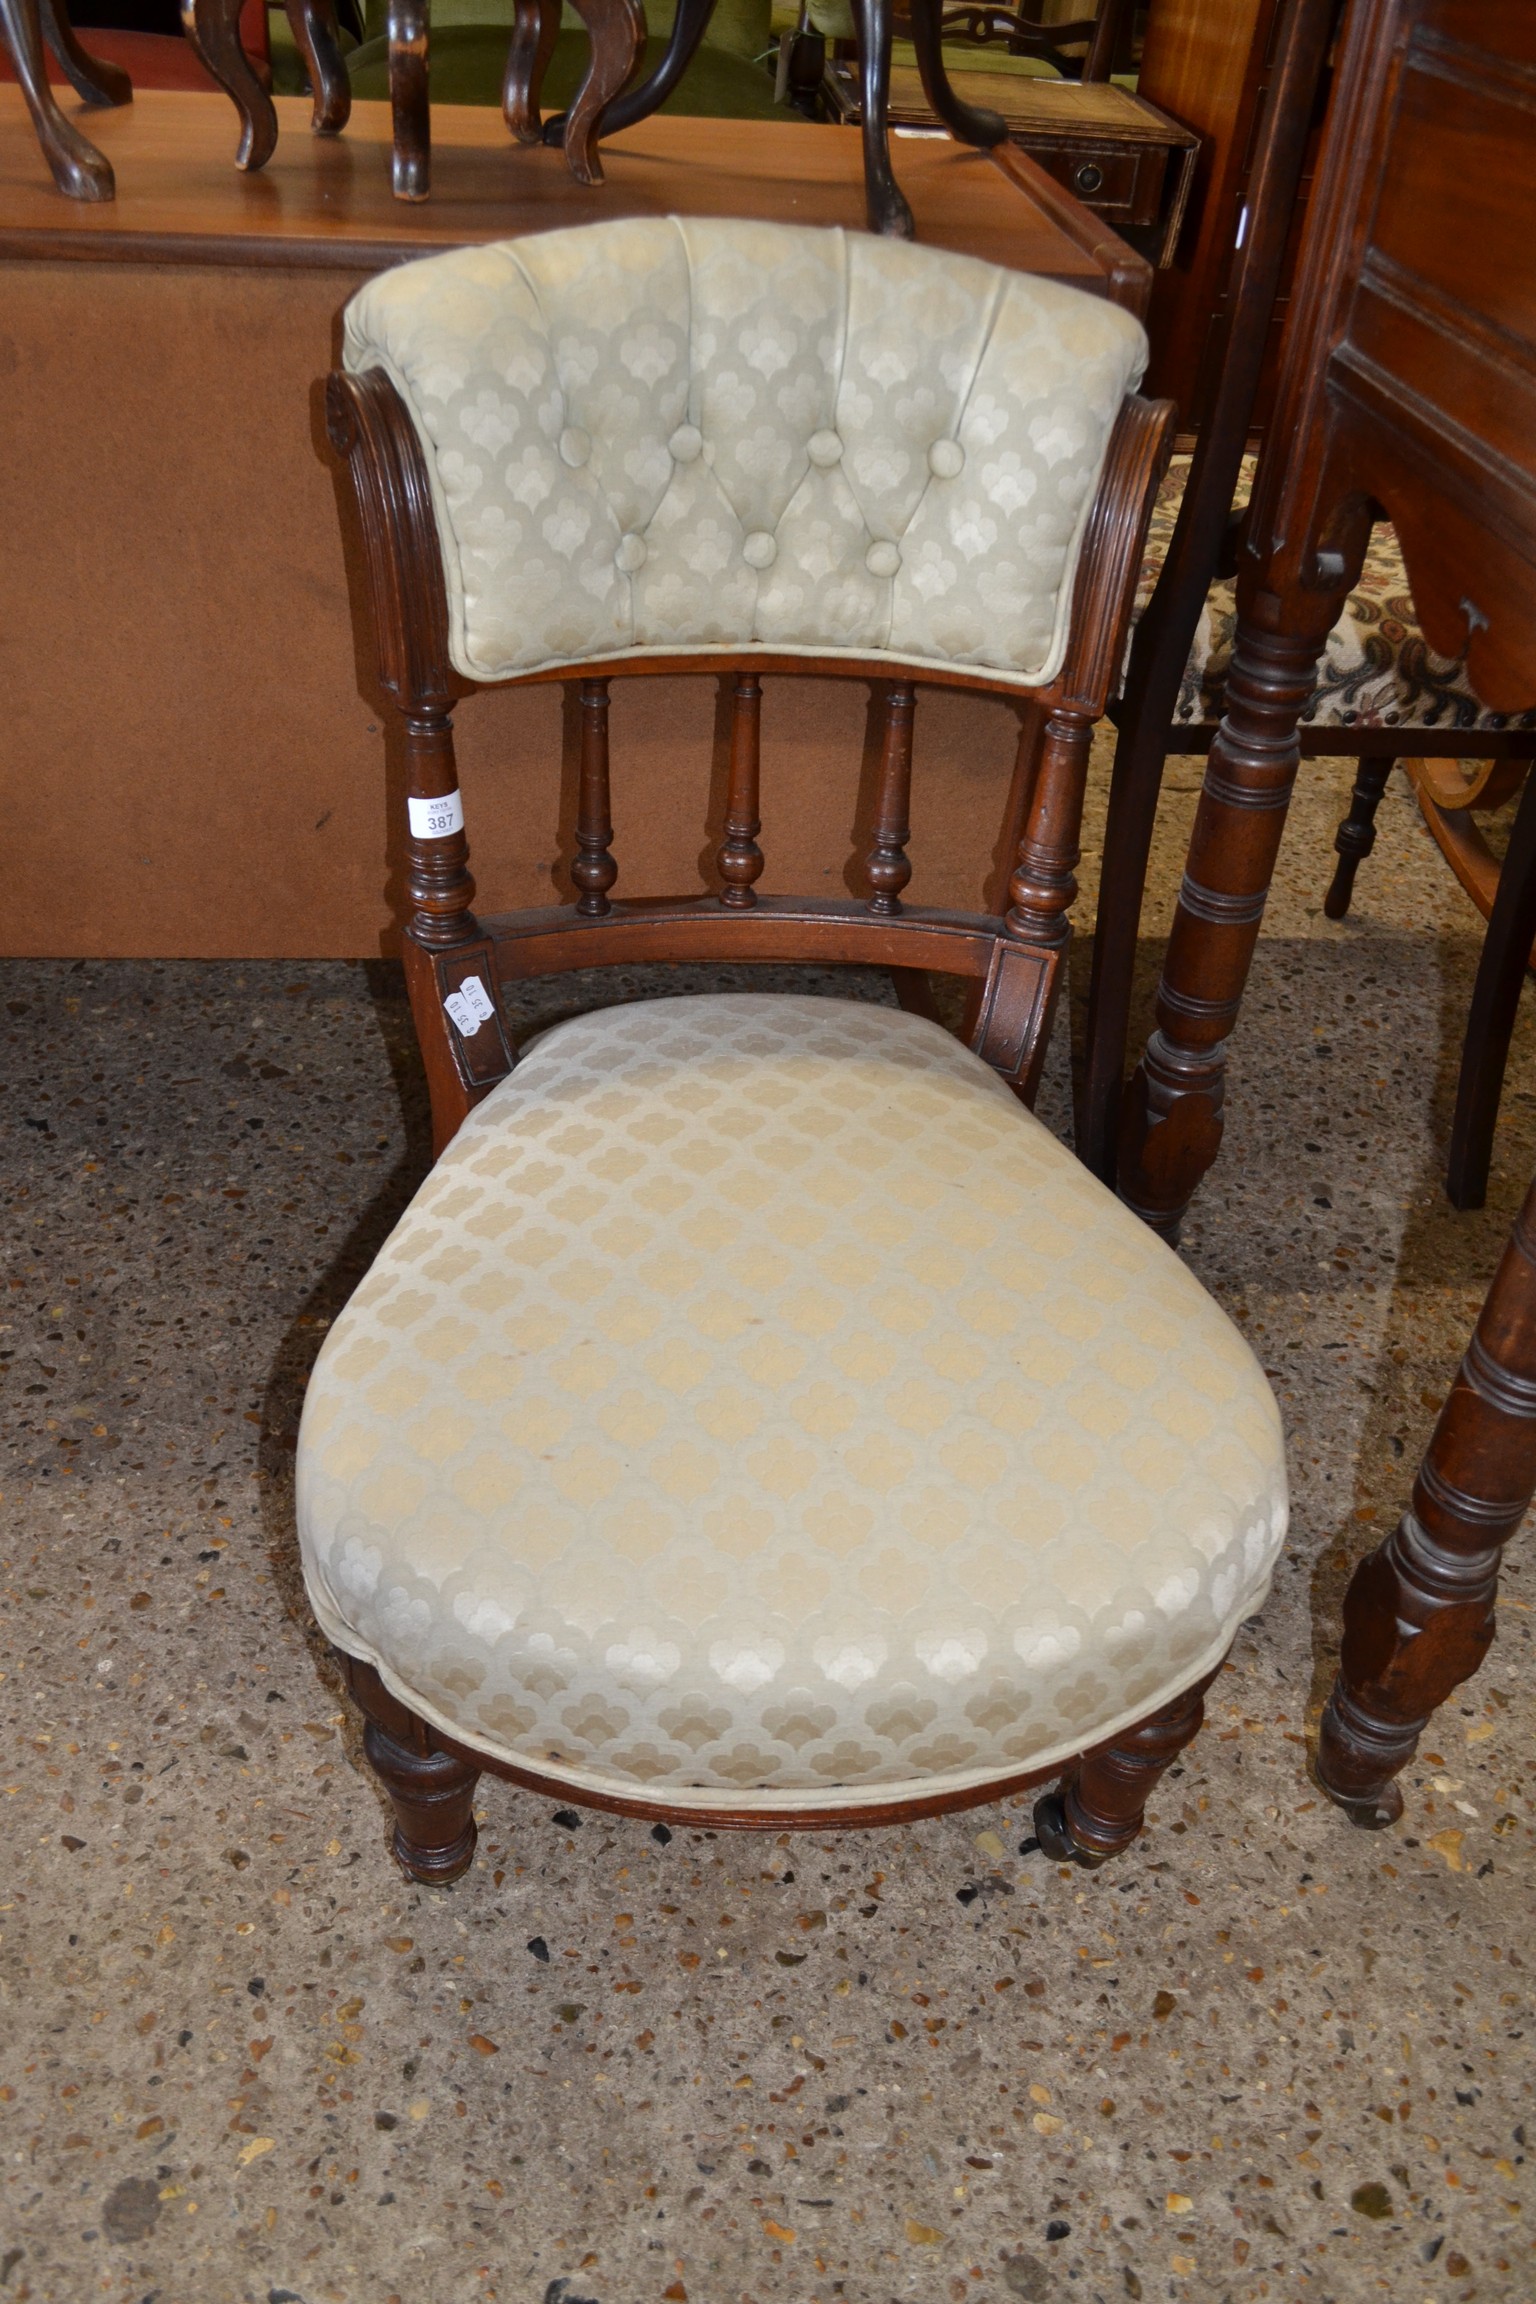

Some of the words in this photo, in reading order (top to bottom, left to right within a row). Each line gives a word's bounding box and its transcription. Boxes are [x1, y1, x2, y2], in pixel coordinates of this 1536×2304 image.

[430, 802, 448, 810] KEYS
[427, 813, 454, 830] 387
[466, 984, 477, 996] 10
[449, 1001, 462, 1013] 10
[471, 998, 483, 1010] 35
[457, 1014, 469, 1026] 35
